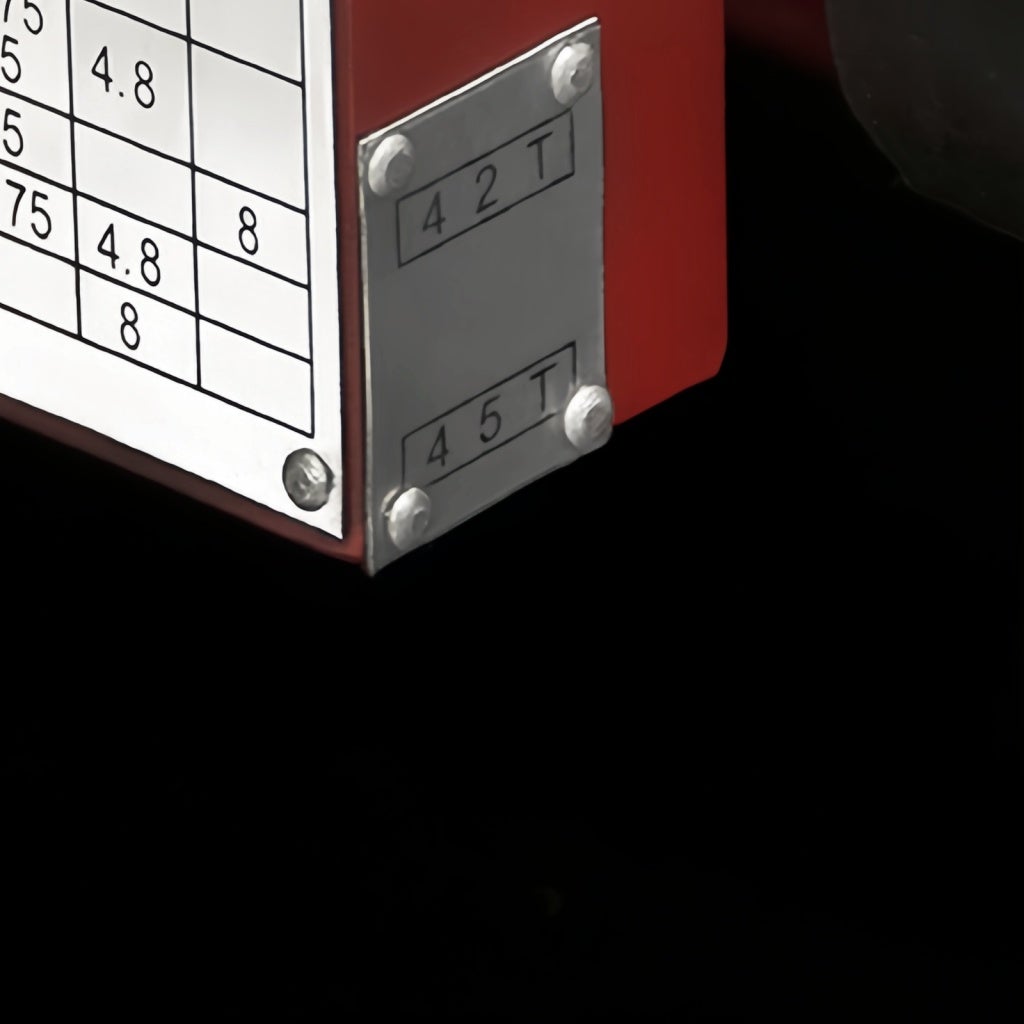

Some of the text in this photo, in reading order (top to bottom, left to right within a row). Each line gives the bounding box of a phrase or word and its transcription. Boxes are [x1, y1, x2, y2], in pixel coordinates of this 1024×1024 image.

[90, 45, 157, 110] 4.8
[96, 223, 162, 288] 4.8
[237, 206, 260, 256] 8
[119, 302, 141, 350] 8
